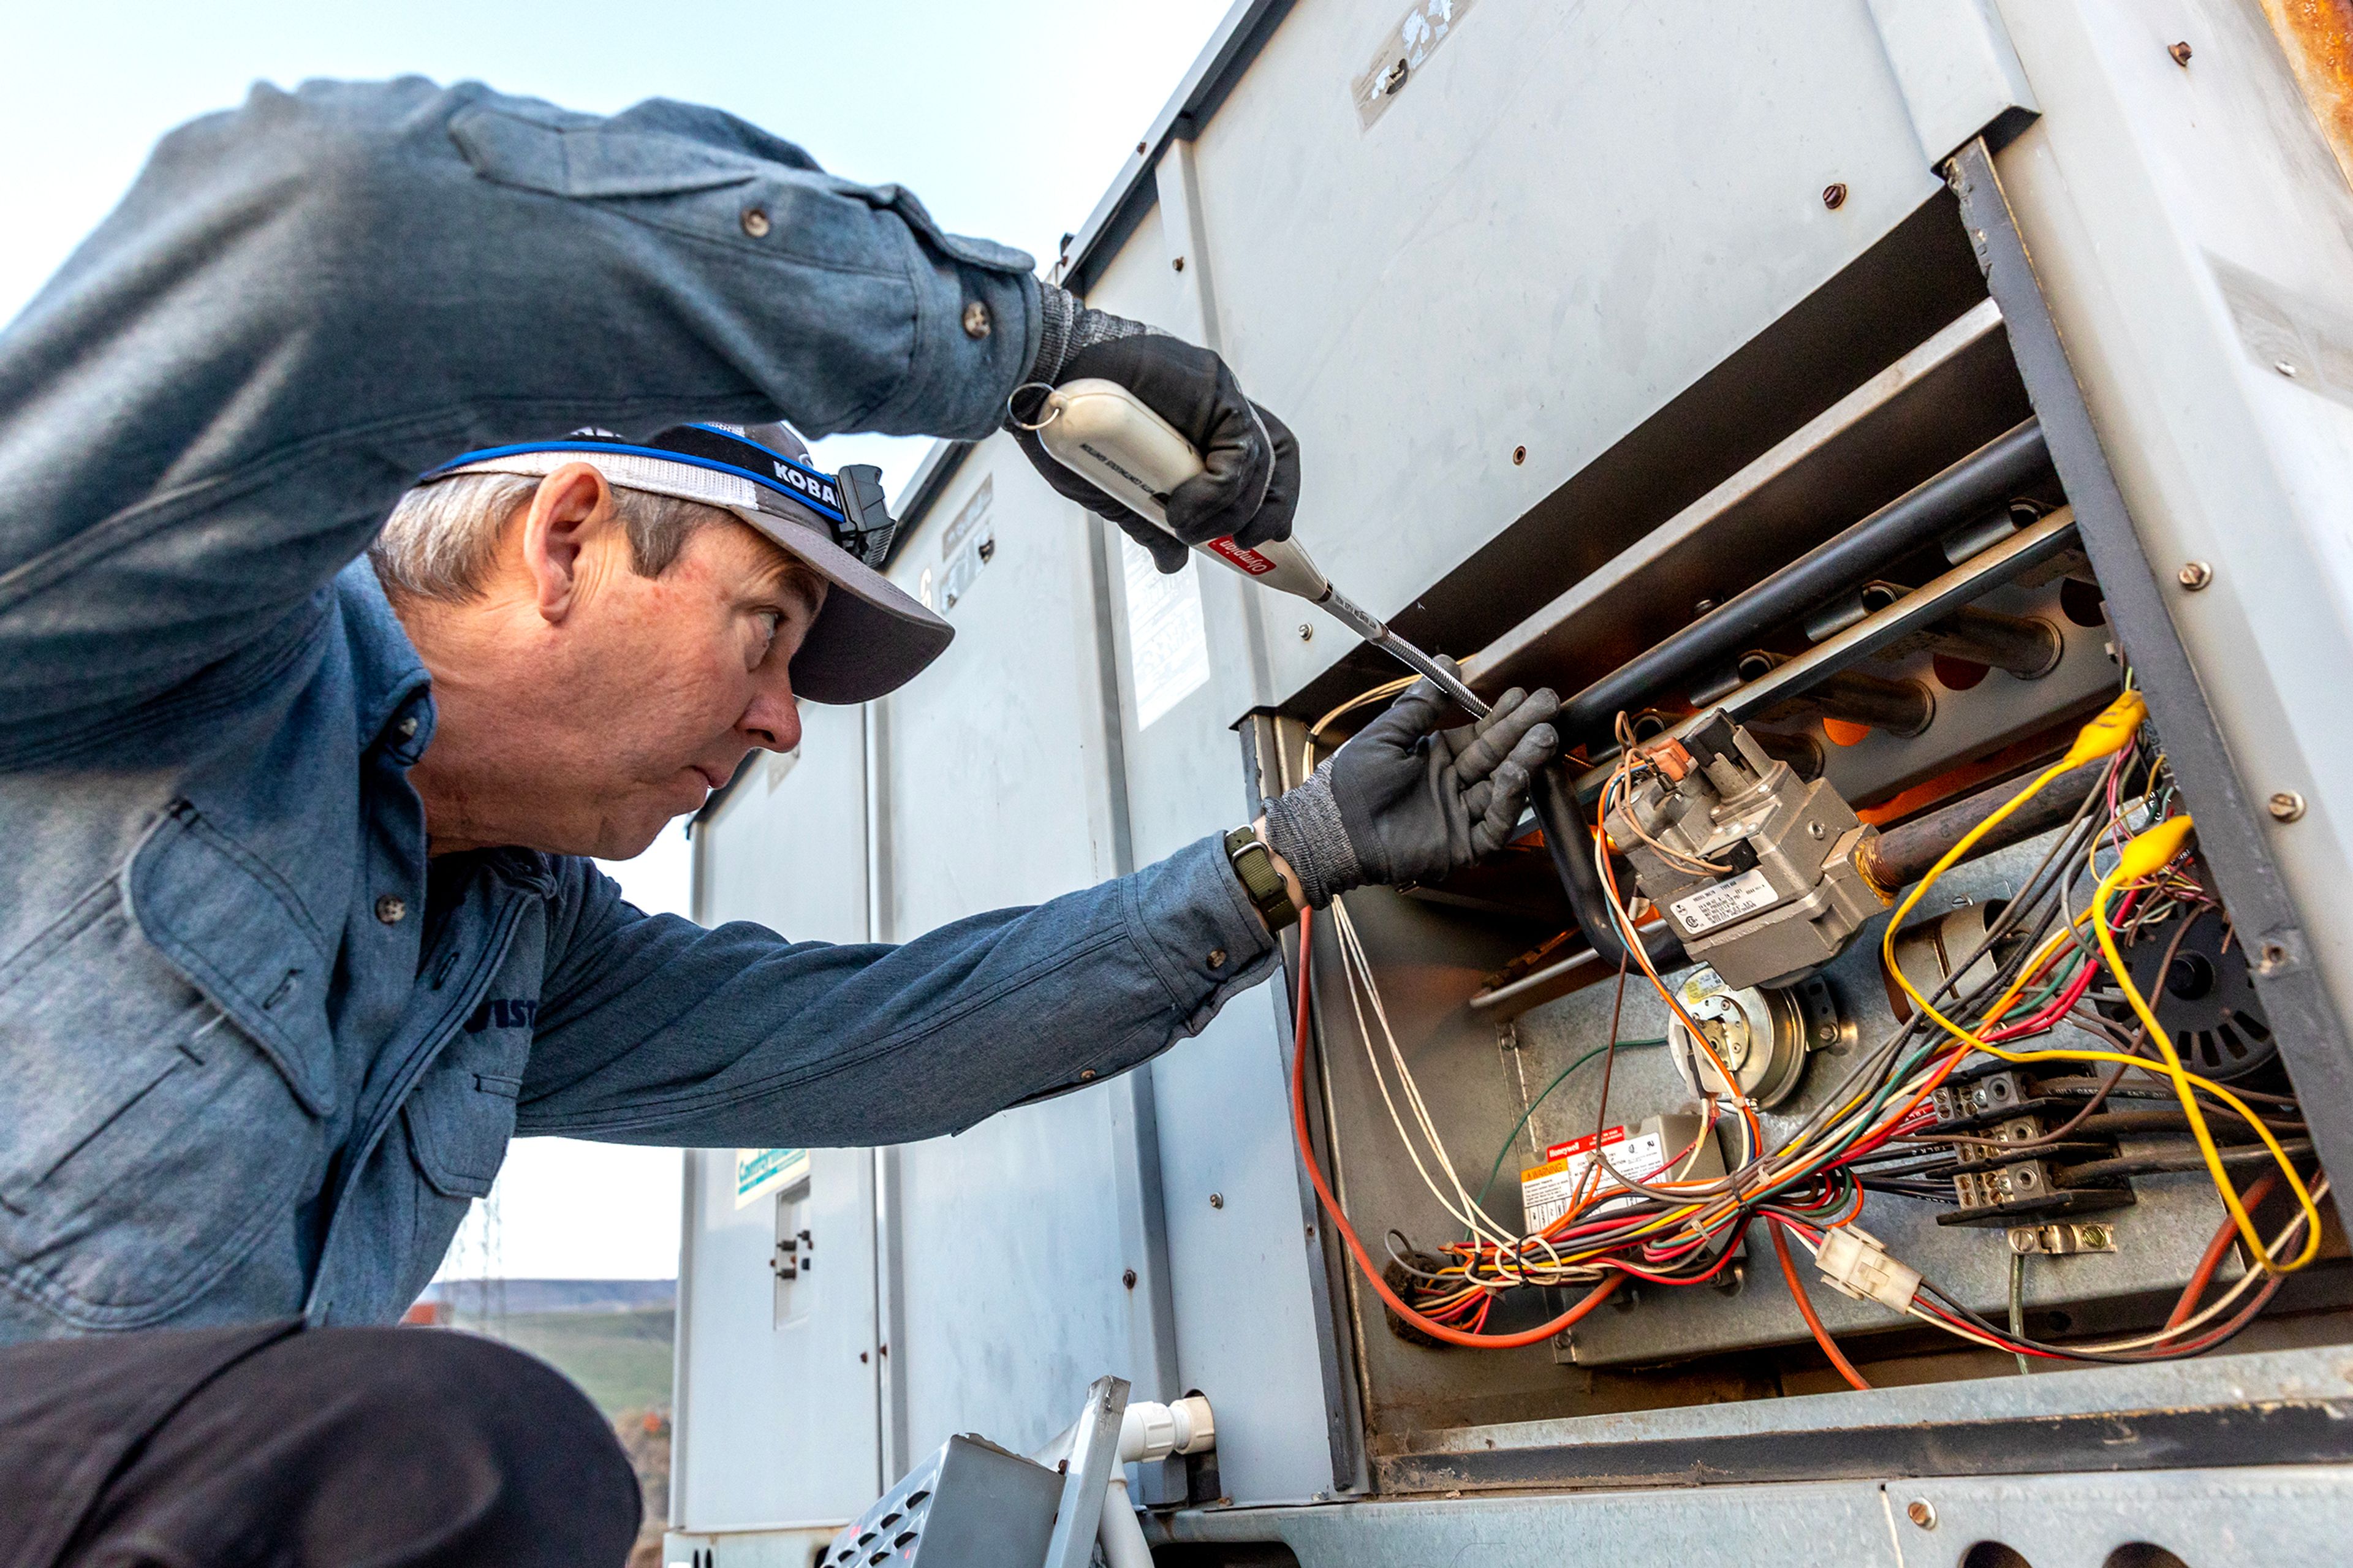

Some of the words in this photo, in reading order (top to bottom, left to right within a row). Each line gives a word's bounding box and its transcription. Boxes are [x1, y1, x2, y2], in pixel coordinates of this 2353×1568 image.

[773, 460, 841, 510] KOBA
[1219, 540, 1267, 572] Olympian
[1549, 1142, 1580, 1157] Honeywell
[1531, 1163, 1563, 1180] WARNING
